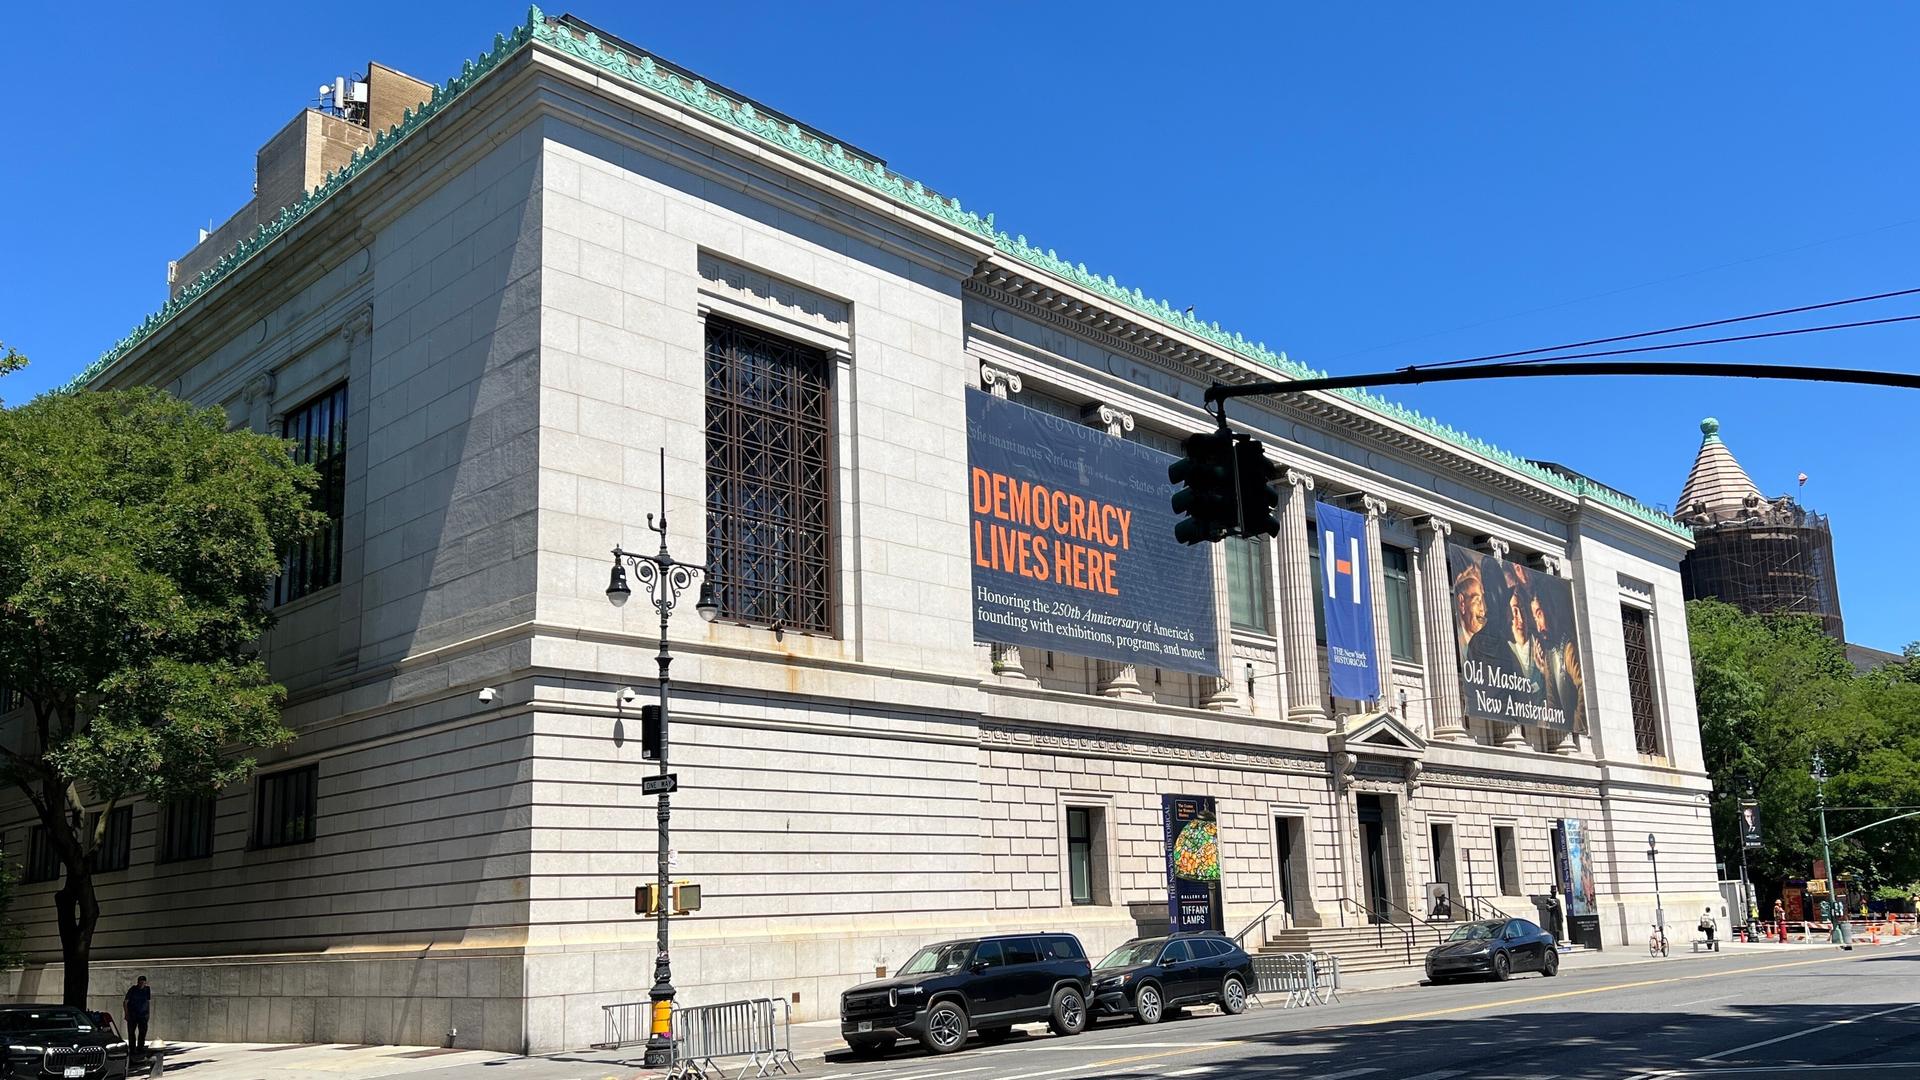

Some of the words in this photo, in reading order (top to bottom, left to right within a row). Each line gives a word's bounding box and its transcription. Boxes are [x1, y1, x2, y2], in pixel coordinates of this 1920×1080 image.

[972, 466, 1132, 550] DEMOCRACY
[975, 520, 1049, 581] LIVES
[1054, 540, 1119, 596] HERE
[977, 586, 1030, 613] Honoring
[1032, 598, 1050, 613] the
[1051, 601, 1081, 620] 250th
[1081, 608, 1142, 633] Anniversary
[1142, 620, 1151, 632] of
[1153, 622, 1194, 641] America's
[977, 607, 1028, 632] founding
[1030, 618, 1054, 634] with
[1056, 623, 1115, 646] exhibitions,
[1116, 635, 1162, 654] programs,
[1163, 644, 1180, 656] and
[1181, 648, 1206, 660] more!
[1463, 660, 1484, 685] Old
[1487, 665, 1531, 693] Masters
[1475, 689, 1502, 714] New
[1505, 694, 1565, 724] Amsterdam
[646, 781, 656, 789] ONE
[661, 780, 671, 788] WAY
[1182, 905, 1208, 914] TIFFANY
[1183, 915, 1205, 925] LAMPS
